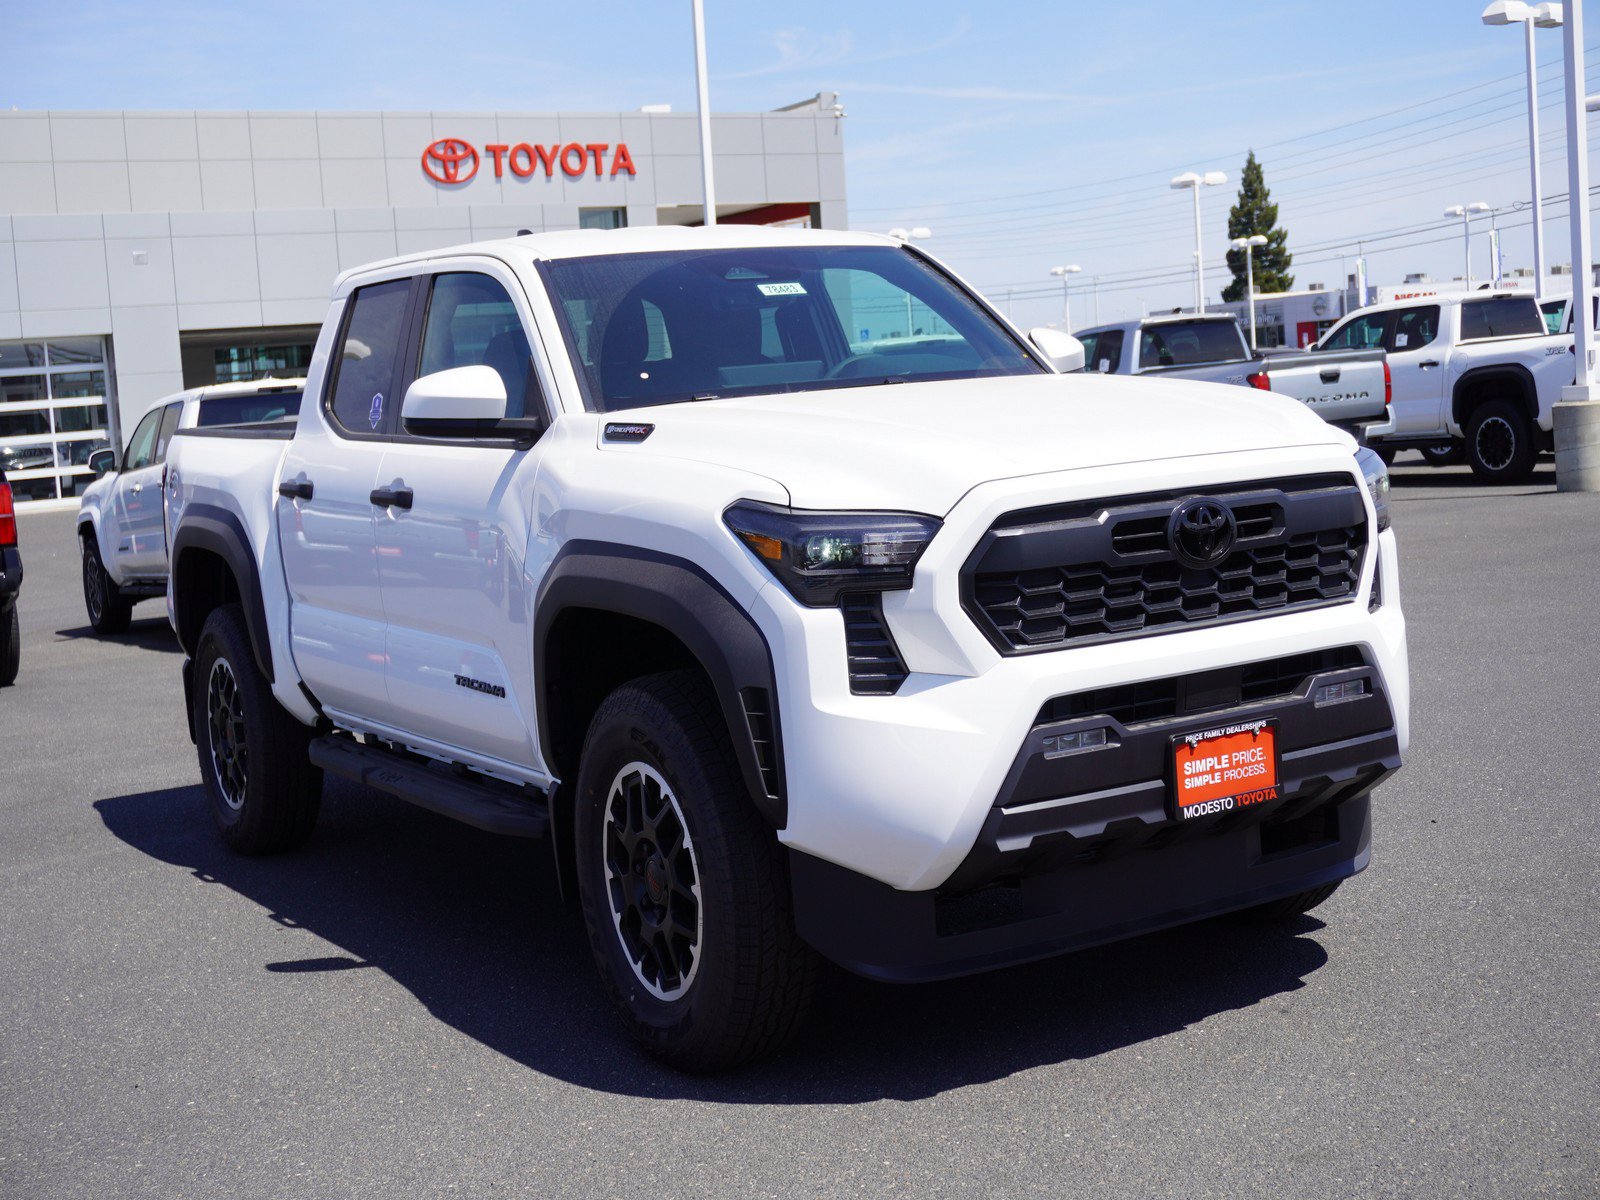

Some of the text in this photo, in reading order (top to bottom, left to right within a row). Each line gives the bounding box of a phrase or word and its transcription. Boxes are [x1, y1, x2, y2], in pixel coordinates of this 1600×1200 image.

[485, 142, 637, 178] TOYOTA
[764, 285, 799, 294] 78483
[454, 674, 506, 699] TACOMA
[1185, 720, 1267, 744] PRICE FAMILY DEALERSHIPS
[1184, 747, 1267, 775] SIMPLE PRICE.
[1184, 763, 1267, 789] SIMPLE PROCESS.
[1183, 788, 1278, 819] MODESTO TOYOTA
